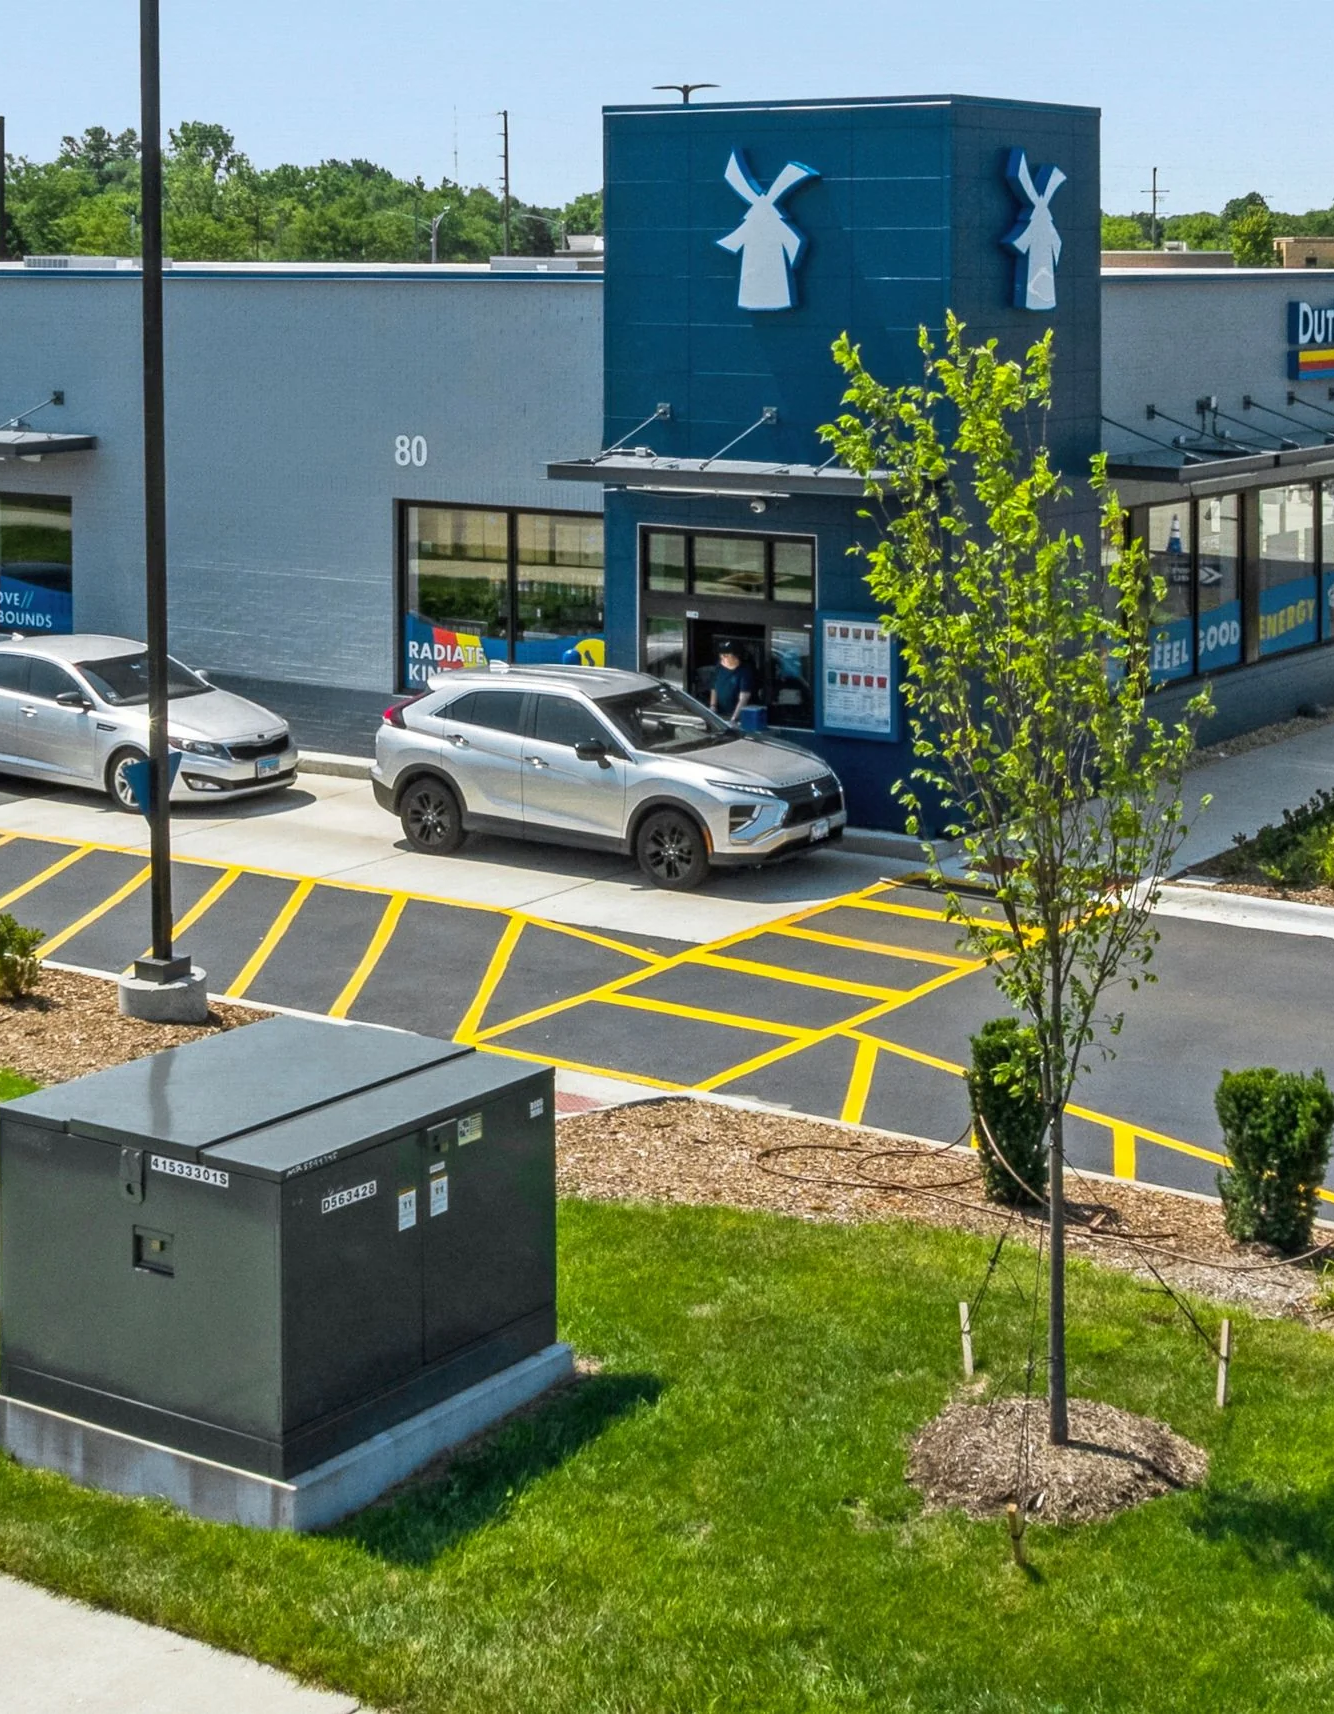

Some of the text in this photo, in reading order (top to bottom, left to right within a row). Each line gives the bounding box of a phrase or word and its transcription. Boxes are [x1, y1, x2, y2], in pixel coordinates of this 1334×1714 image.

[395, 434, 428, 467] 80
[1259, 598, 1316, 640] ENERGY
[408, 641, 485, 664] RADIATE
[1153, 619, 1240, 670] FEEL GOOD
[408, 662, 452, 682] KIN
